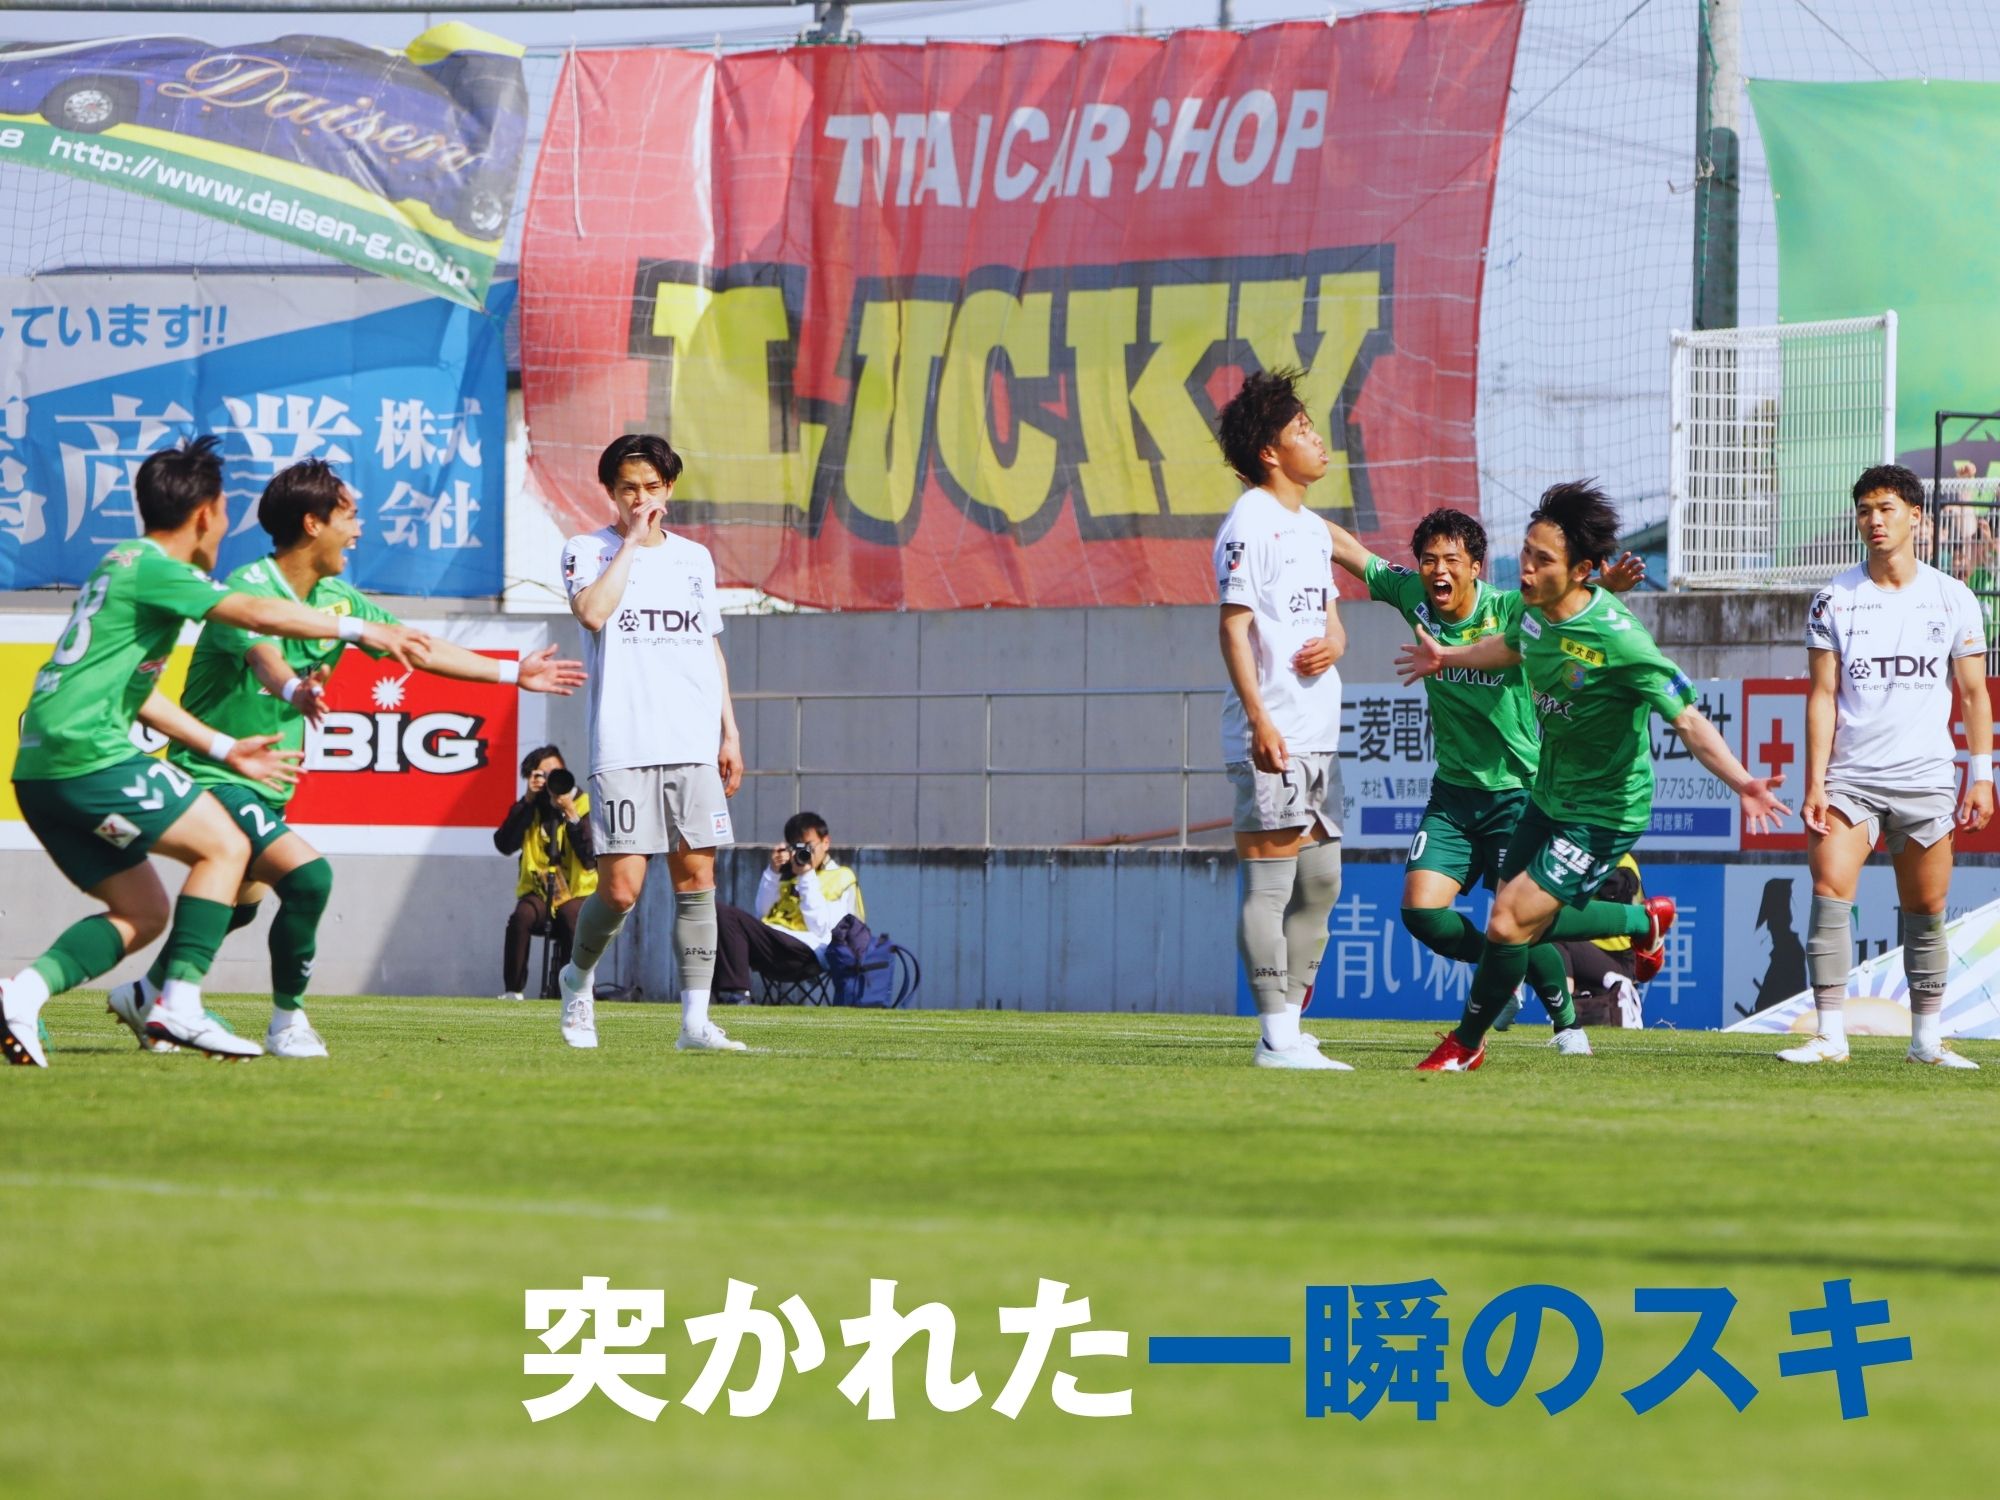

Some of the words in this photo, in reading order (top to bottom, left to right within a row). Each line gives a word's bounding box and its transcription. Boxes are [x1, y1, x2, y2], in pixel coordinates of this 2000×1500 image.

[157, 54, 494, 173] Daisen
[0, 304, 229, 348] ています!!
[640, 256, 1390, 536] LUCKY
[379, 481, 483, 551] 会社
[640, 609, 703, 633] TDK
[1871, 655, 1939, 678] TDK
[303, 710, 487, 774] BIG
[1281, 769, 1299, 806] 5
[604, 799, 635, 834] 10
